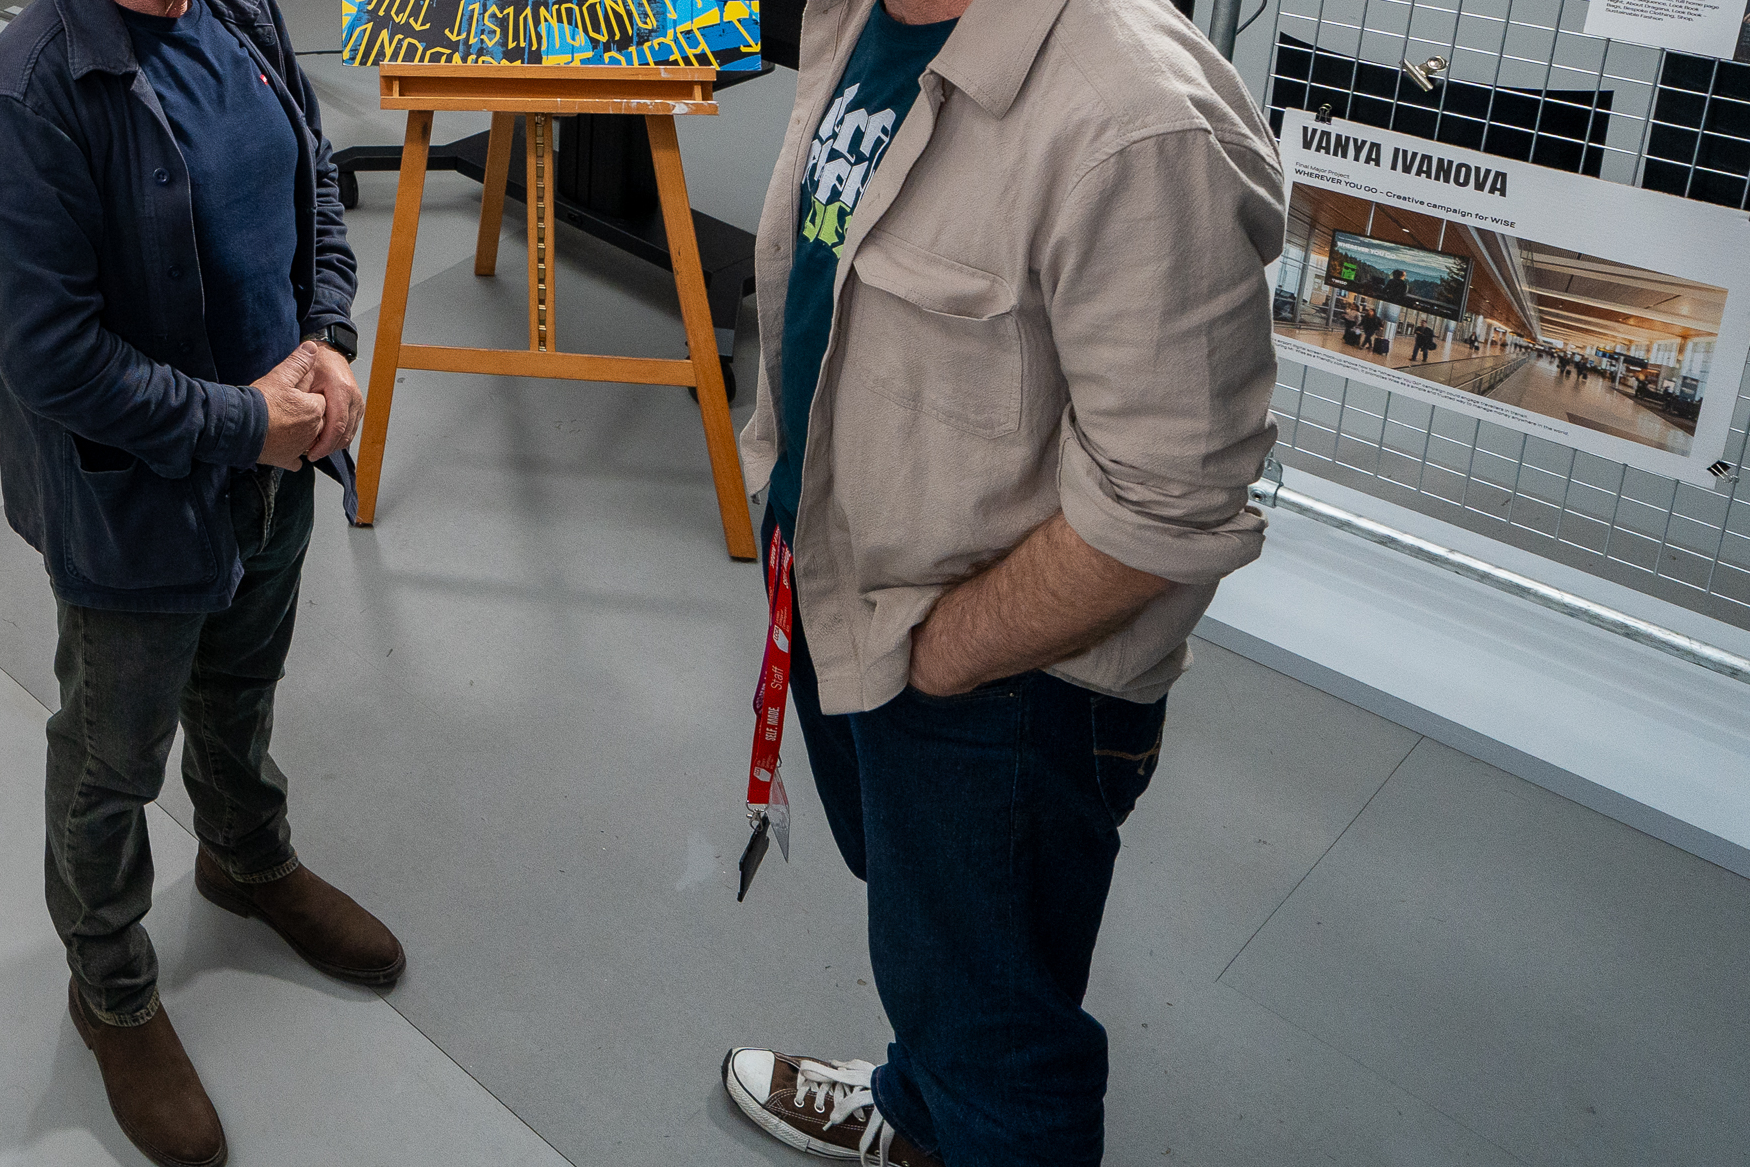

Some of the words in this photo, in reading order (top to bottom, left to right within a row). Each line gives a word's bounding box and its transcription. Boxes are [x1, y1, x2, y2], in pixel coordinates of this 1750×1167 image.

[1295, 161, 1310, 170] Final
[1310, 165, 1327, 175] Major
[1328, 169, 1350, 180] Project
[1302, 125, 1382, 167] VANYA
[1390, 146, 1508, 198] IVANOVA
[1294, 168, 1342, 185] WHEREVER
[1344, 180, 1362, 191] YOU
[1364, 185, 1378, 194] GO
[1386, 190, 1425, 206] Creative
[1426, 202, 1473, 219] campaign
[1475, 212, 1489, 222] for
[1490, 216, 1516, 229] WISE
[771, 665, 784, 691] Staff
